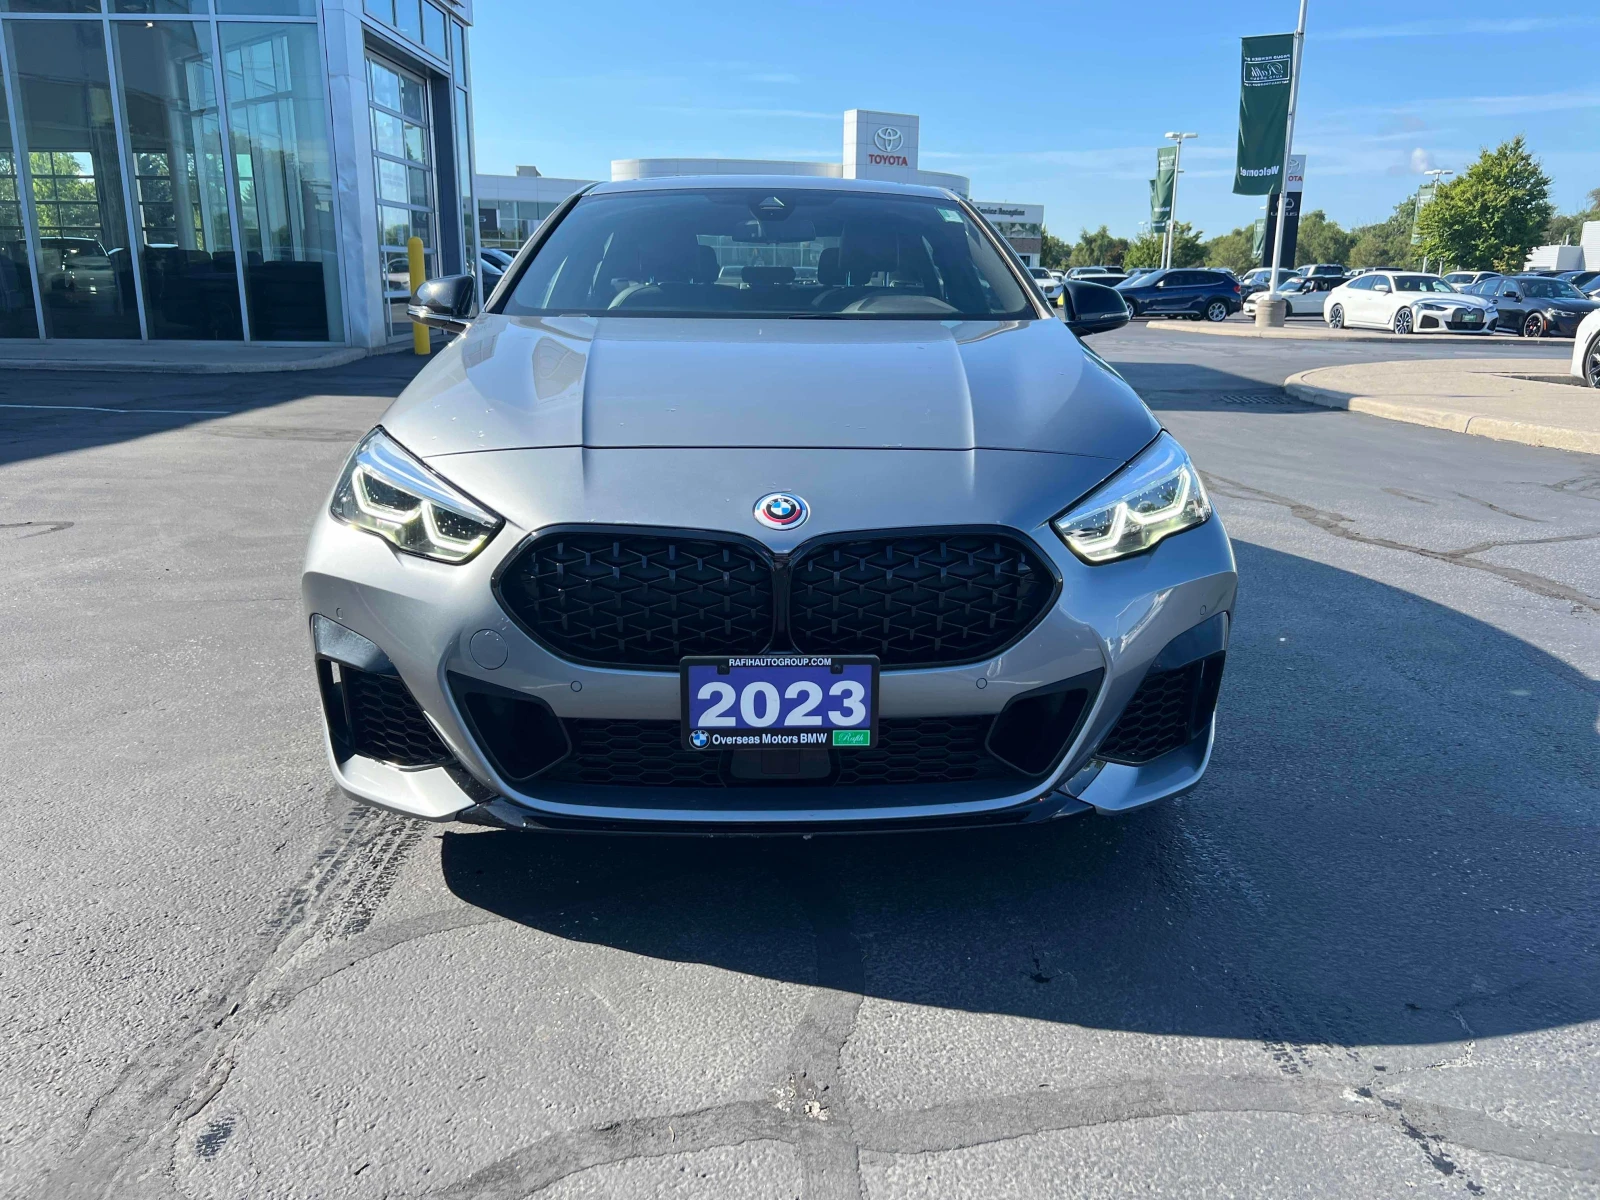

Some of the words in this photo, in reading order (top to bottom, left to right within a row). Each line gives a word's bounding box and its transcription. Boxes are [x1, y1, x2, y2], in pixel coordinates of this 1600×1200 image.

[868, 154, 908, 166] TOYOTA
[998, 207, 1025, 217] Reception
[728, 658, 832, 667] RAFIHAUTOGROUP.COM
[697, 680, 866, 727] 2023
[712, 733, 760, 745] Overseas
[762, 733, 798, 744] Motors
[800, 732, 827, 744] BMW
